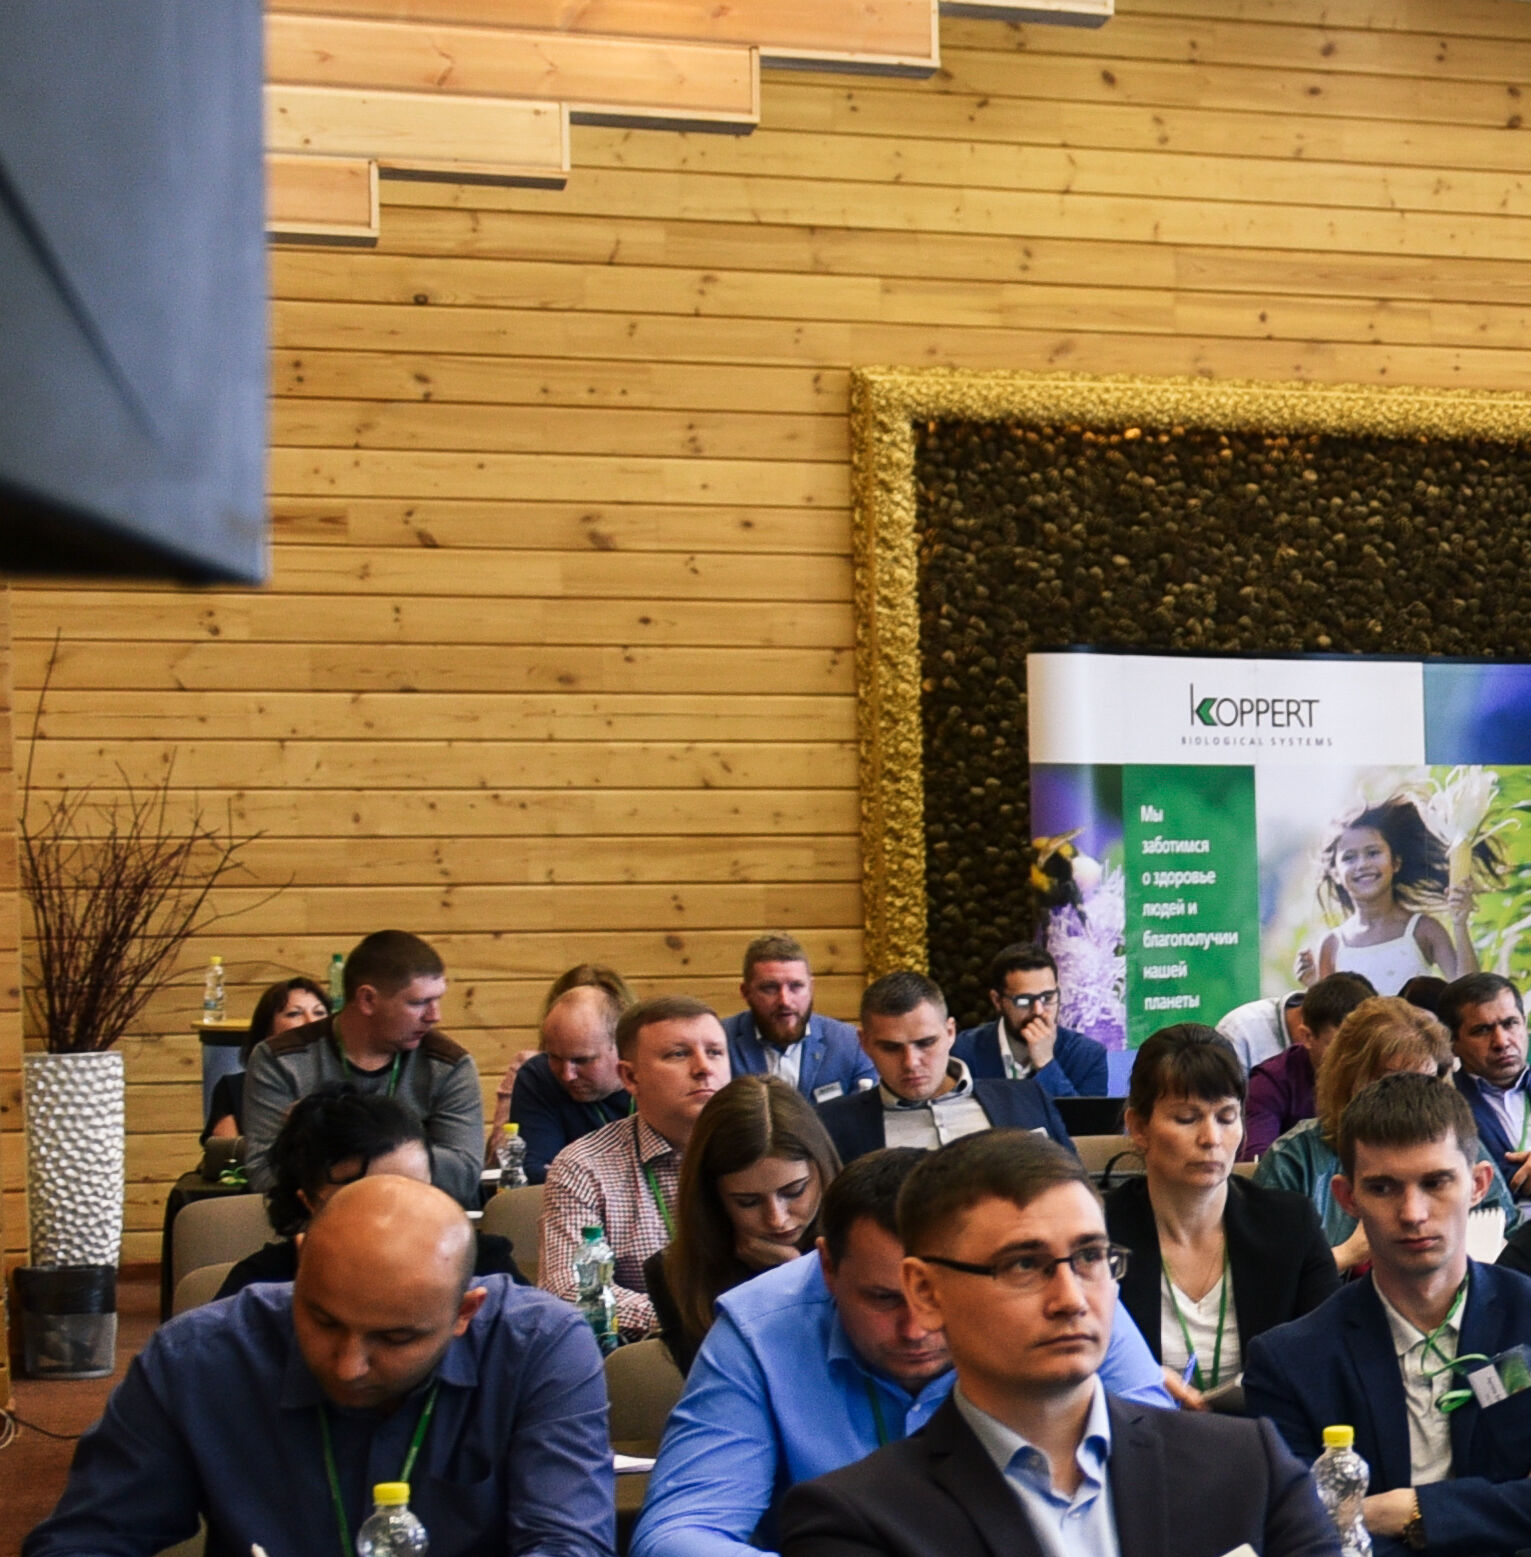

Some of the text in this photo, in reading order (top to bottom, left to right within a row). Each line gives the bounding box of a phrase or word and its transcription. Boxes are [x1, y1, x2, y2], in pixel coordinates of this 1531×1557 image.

[1190, 683, 1320, 728] KOPPERT
[1181, 736, 1333, 747] BIOLOGICAL SYSTEMS
[1140, 805, 1164, 822] Мы
[1142, 835, 1210, 854] заботимся
[1142, 871, 1217, 888] о здоровье
[1142, 898, 1198, 919] людей и
[1143, 930, 1239, 951] благополучии
[1143, 960, 1188, 979] нашей
[1144, 994, 1200, 1011] планеты
